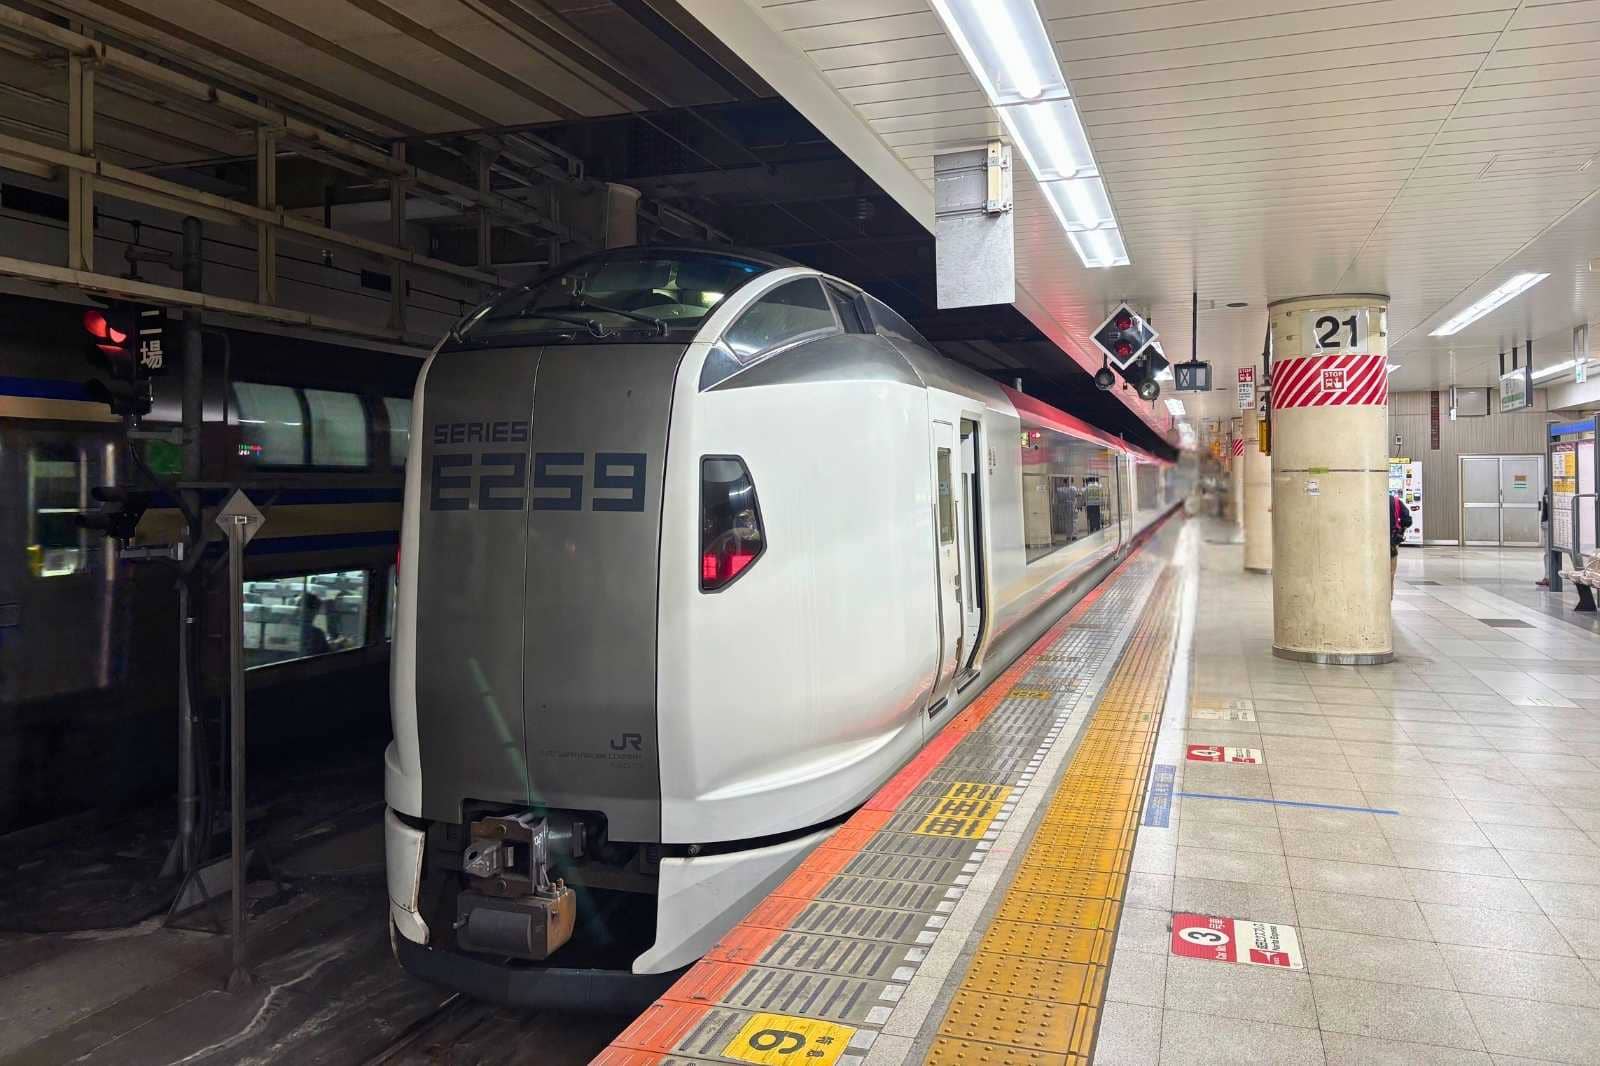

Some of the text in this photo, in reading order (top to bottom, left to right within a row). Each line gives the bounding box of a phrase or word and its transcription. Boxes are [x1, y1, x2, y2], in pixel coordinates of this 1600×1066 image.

[1315, 315, 1358, 348] 21
[433, 421, 528, 444] SERIES
[431, 452, 647, 512] E259
[610, 733, 642, 751] JR
[1188, 931, 1221, 942] 3
[748, 1029, 807, 1055] 9
